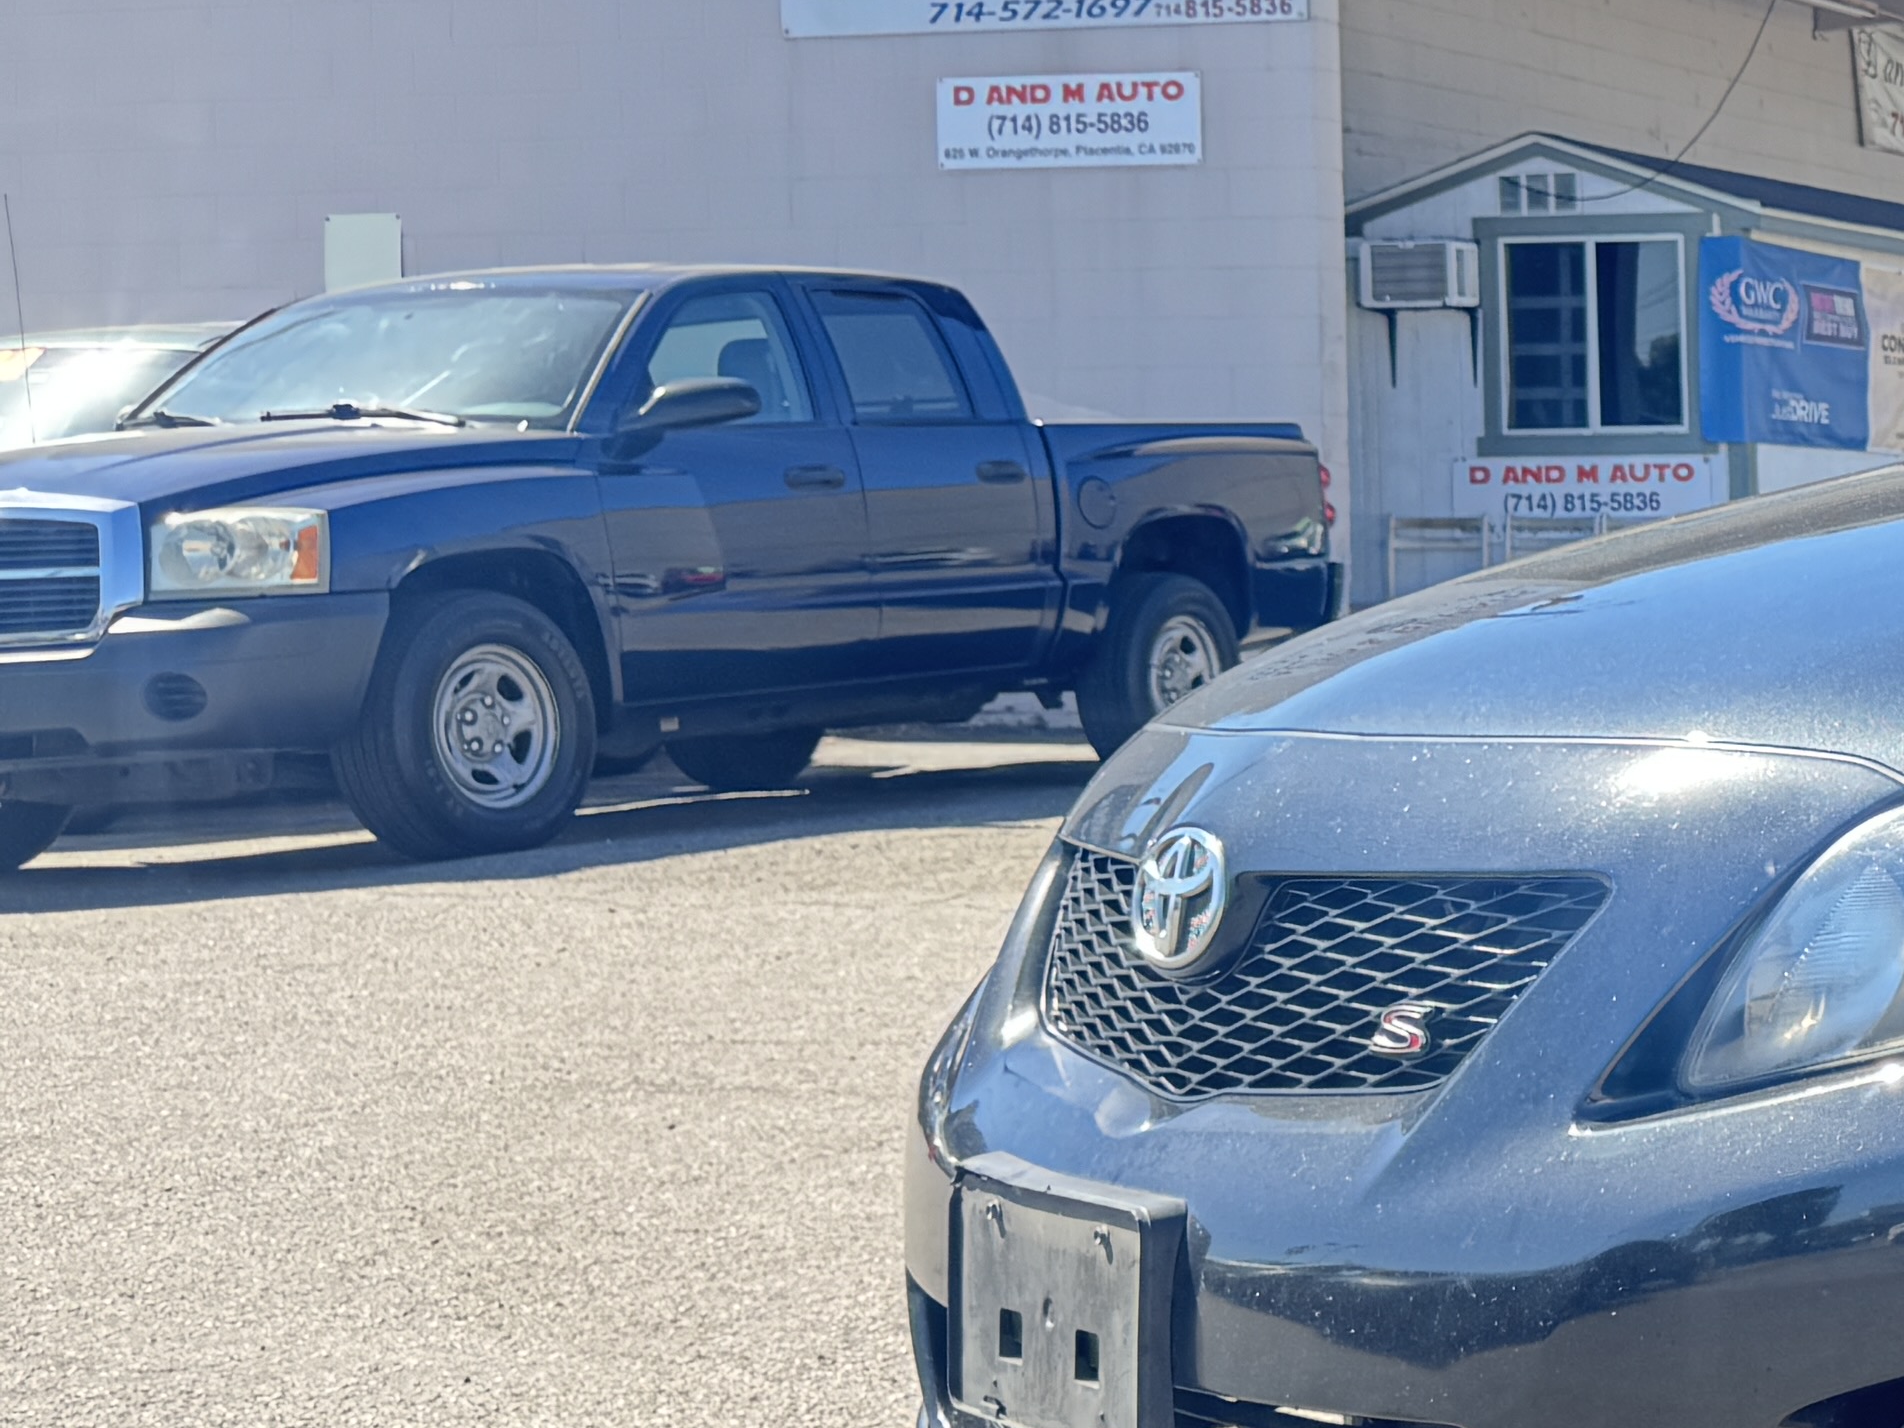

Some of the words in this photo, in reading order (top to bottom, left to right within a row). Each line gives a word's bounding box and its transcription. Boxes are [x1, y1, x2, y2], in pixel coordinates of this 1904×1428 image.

[953, 86, 975, 107] D
[985, 83, 1051, 106] AND
[1062, 82, 1085, 104] M
[1096, 79, 1185, 103] AUTO
[987, 113, 1042, 141] (714)
[1048, 110, 1150, 136] 815-5836
[1740, 276, 1783, 309] GWC
[1469, 466, 1491, 484] D
[1502, 465, 1566, 484] AND
[1577, 464, 1599, 483] M
[1609, 462, 1695, 483] AUTO
[1503, 492, 1556, 518] (714)
[1563, 490, 1661, 514] 815-5836
